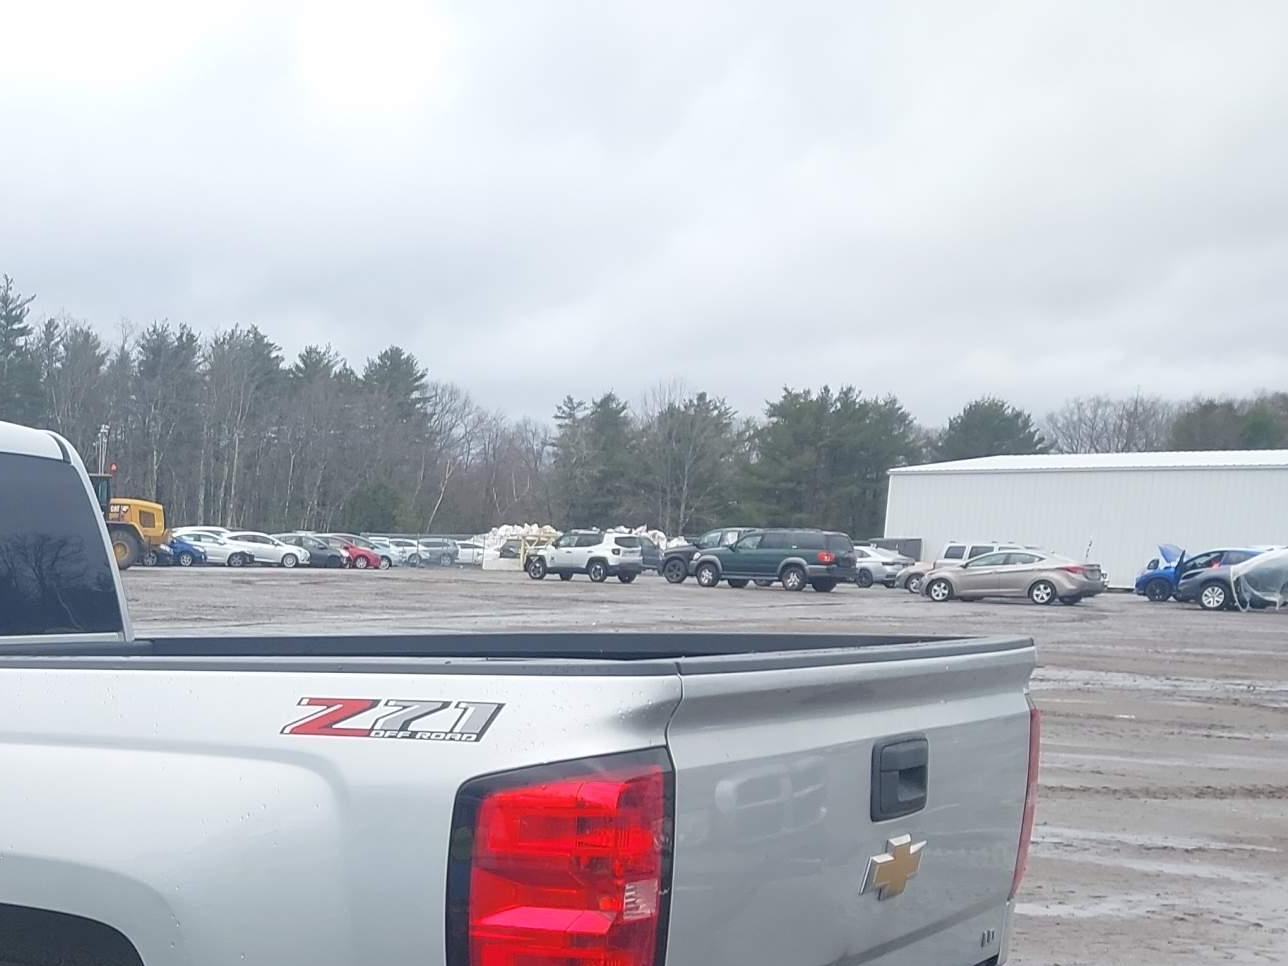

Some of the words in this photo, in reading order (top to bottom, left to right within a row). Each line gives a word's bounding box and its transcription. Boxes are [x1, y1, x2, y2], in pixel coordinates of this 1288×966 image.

[279, 697, 506, 742] Z71
[369, 730, 411, 739] OFF
[415, 731, 478, 741] ROAD
